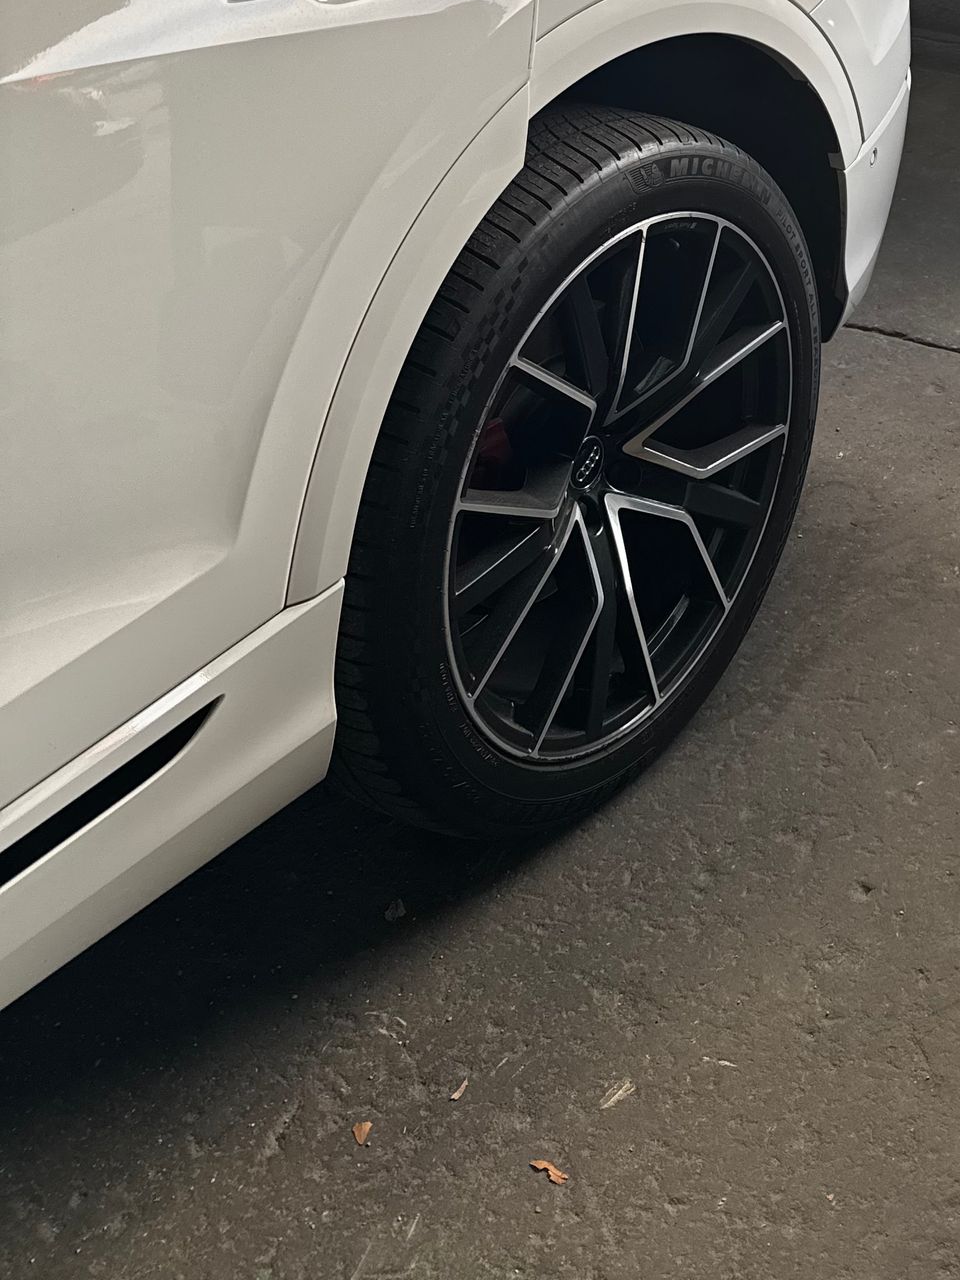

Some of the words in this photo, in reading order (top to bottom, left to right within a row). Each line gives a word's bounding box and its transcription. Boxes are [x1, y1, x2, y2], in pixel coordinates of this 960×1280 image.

[670, 157, 773, 206] MICHELIN
[776, 208, 796, 241] PILOT
[794, 243, 812, 286] SPORT
